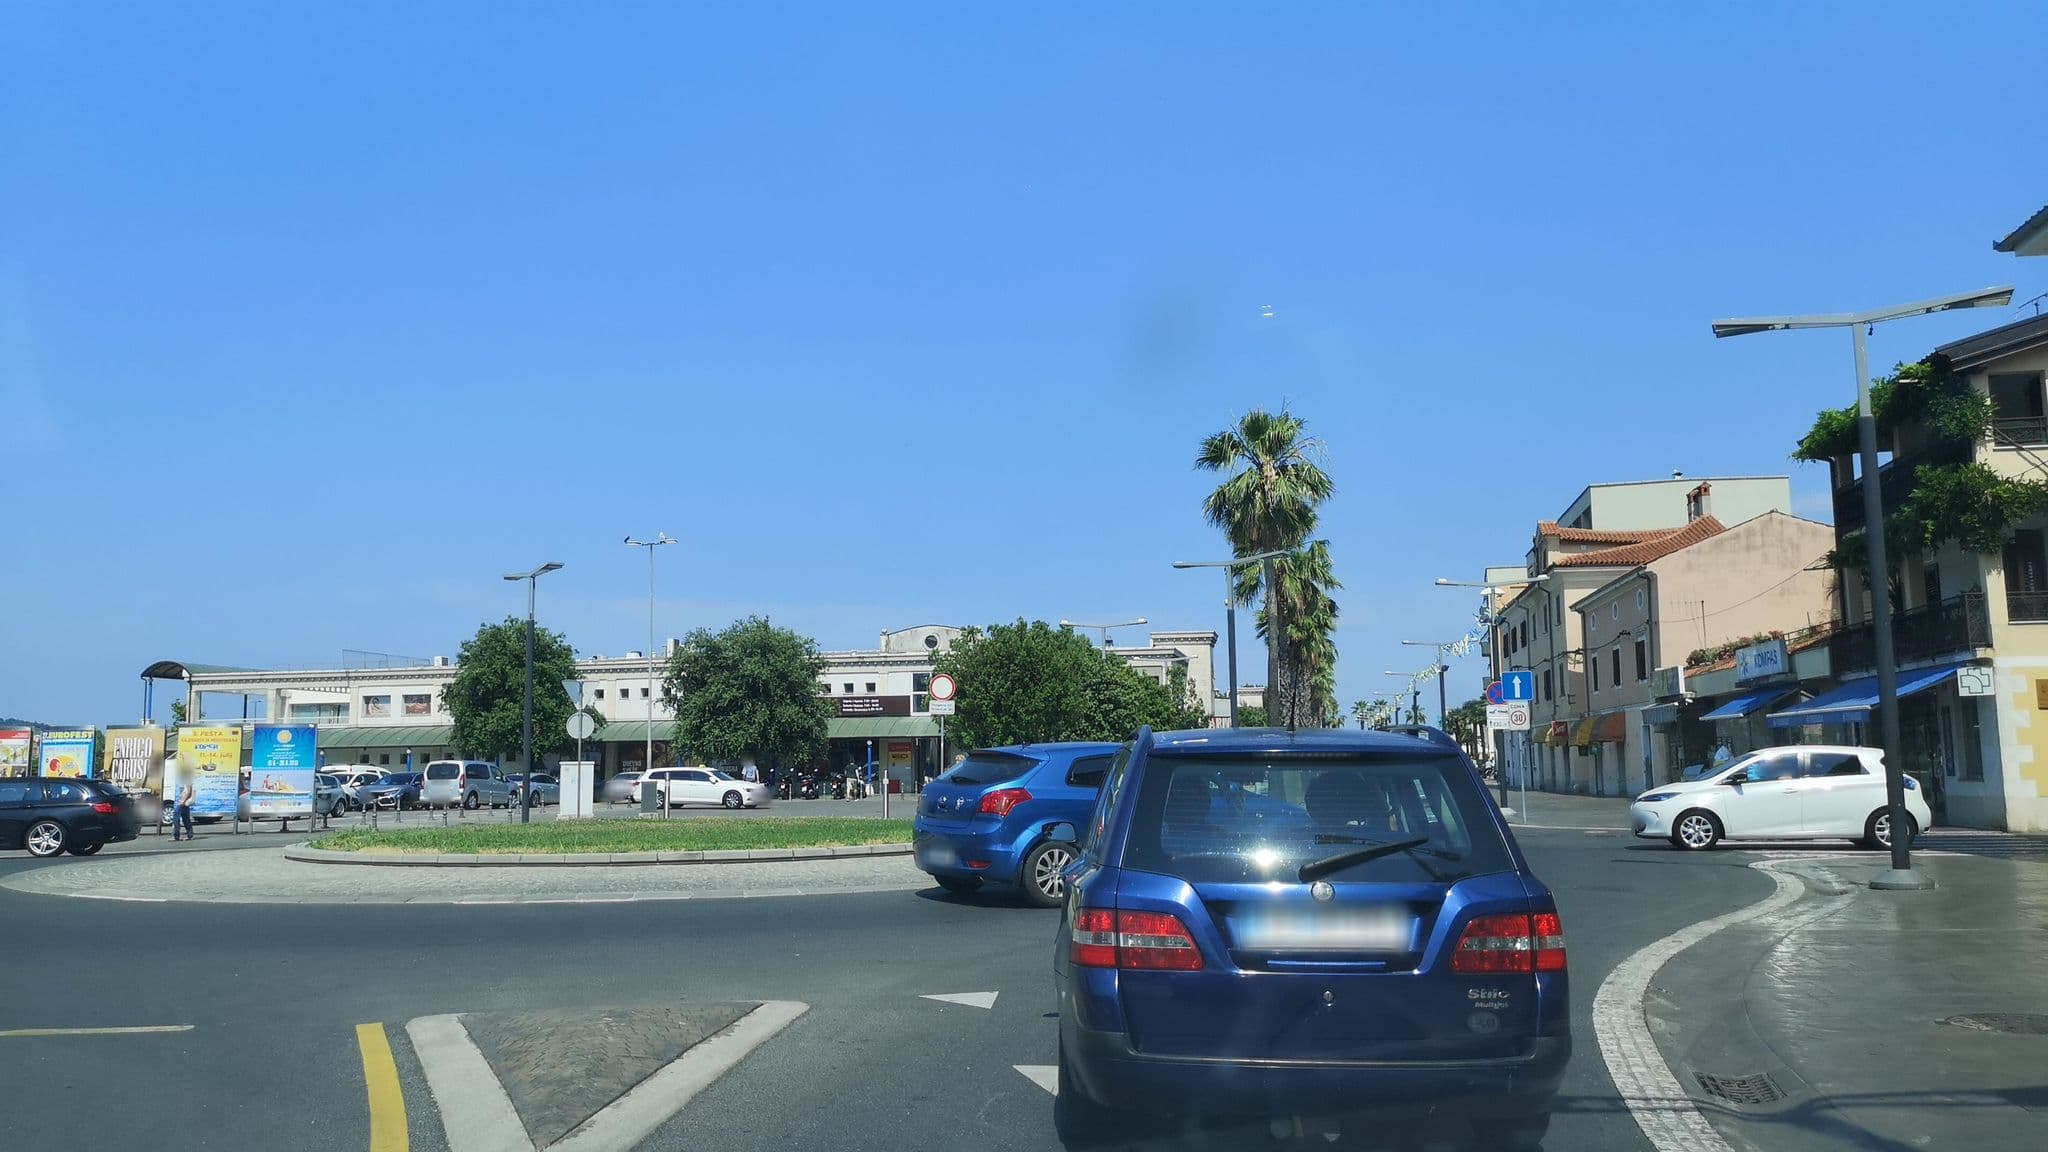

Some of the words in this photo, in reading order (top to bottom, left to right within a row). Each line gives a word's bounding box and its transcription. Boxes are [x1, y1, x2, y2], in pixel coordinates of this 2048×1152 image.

[1753, 648, 1777, 667] KOMPAS
[1513, 714, 1523, 722] 30
[114, 736, 153, 759] ENRICO
